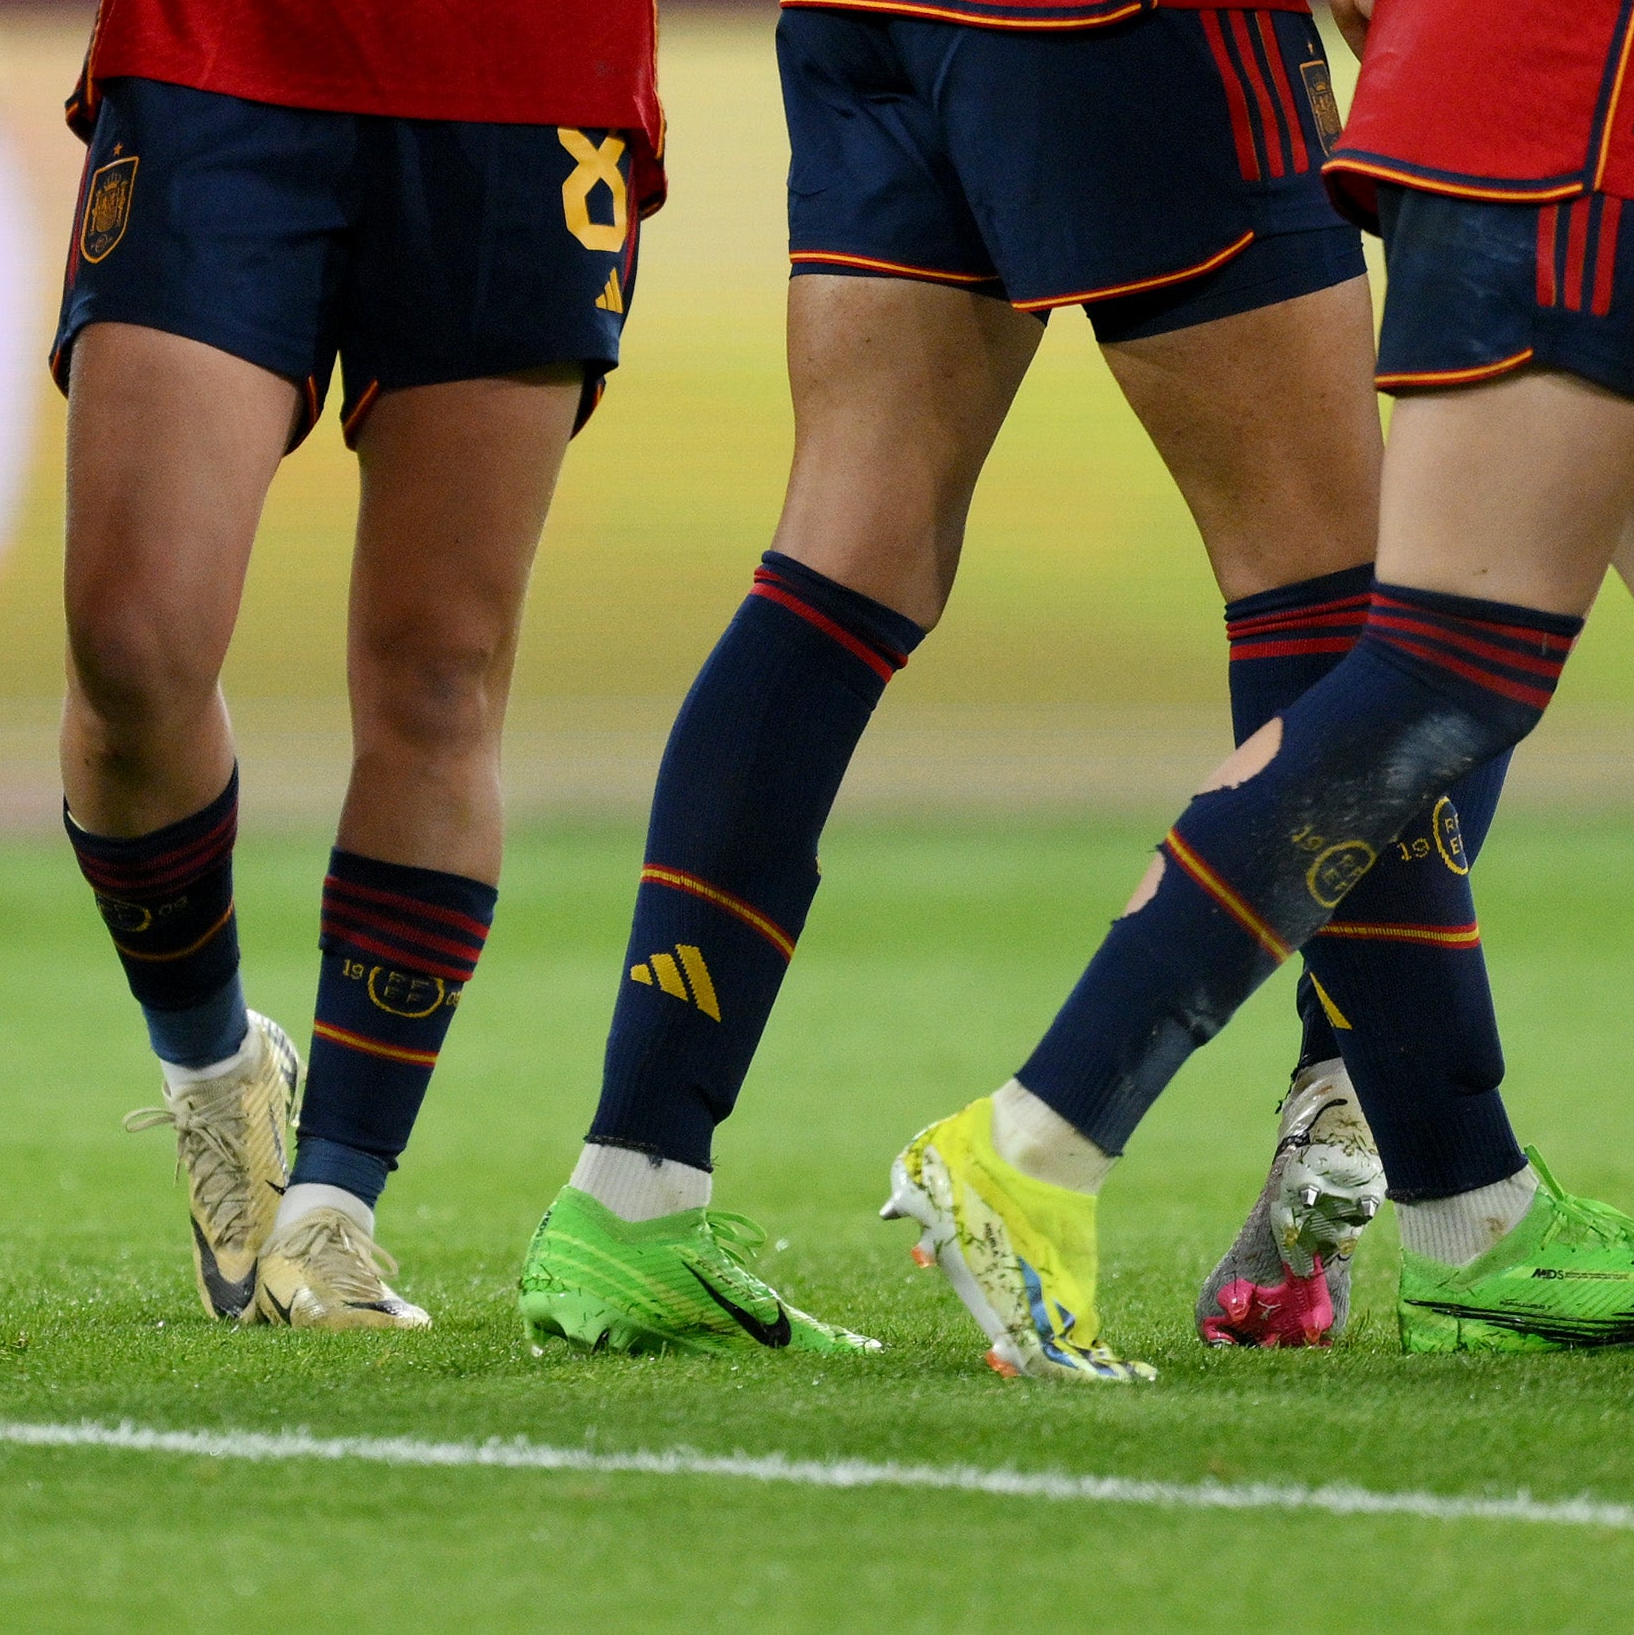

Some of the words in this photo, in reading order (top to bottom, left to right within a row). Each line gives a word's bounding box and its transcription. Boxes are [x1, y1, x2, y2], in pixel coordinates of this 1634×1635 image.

[556, 127, 629, 252] 8
[1396, 837, 1430, 862] 19
[342, 958, 365, 980] 19
